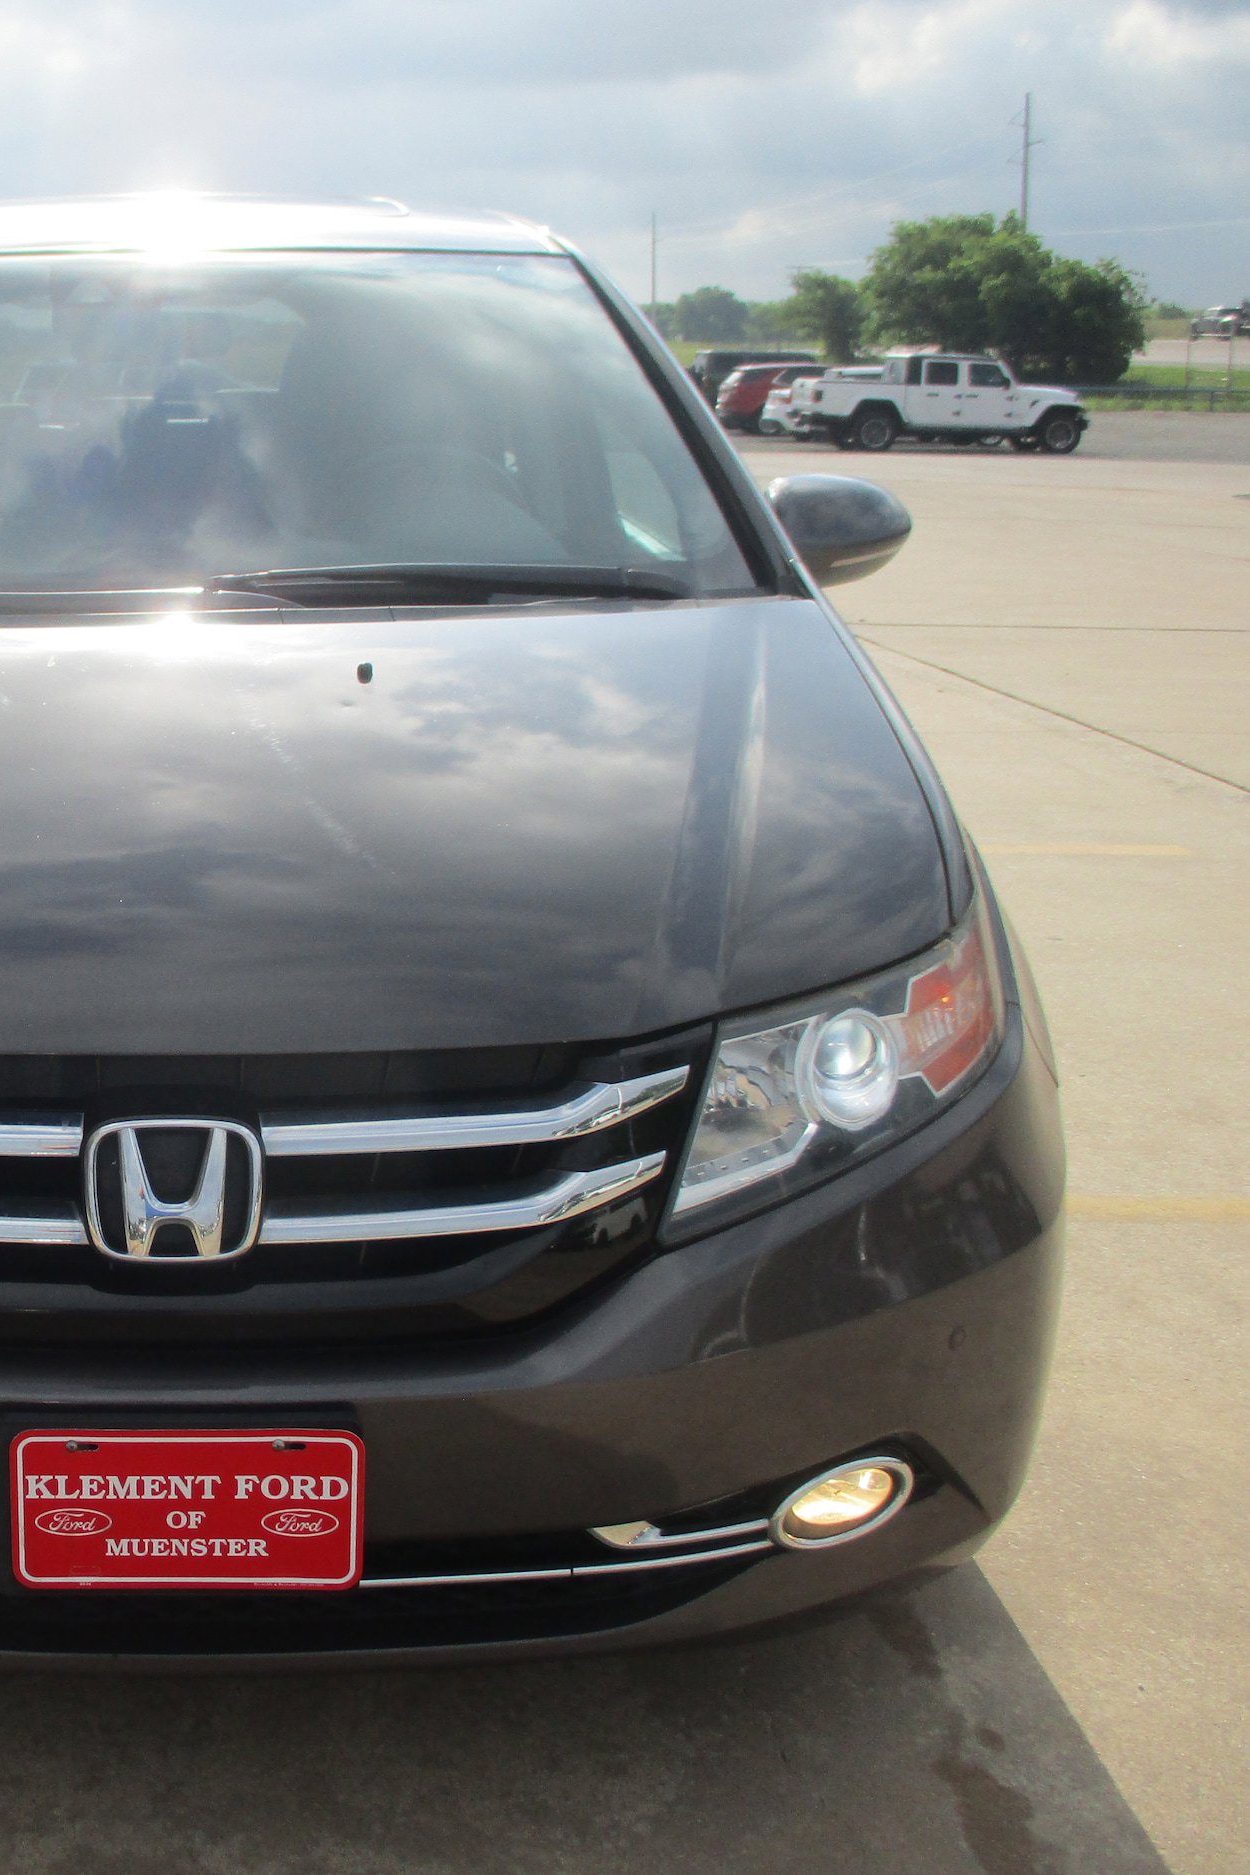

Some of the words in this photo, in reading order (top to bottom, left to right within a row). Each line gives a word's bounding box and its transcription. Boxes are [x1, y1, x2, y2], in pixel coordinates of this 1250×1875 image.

[25, 1475, 221, 1499] KLEMENT
[235, 1475, 348, 1500] FORD
[49, 1512, 96, 1532] Ford
[166, 1511, 206, 1528] OF
[274, 1512, 323, 1533] Ford
[106, 1538, 269, 1556] MUENSTER
